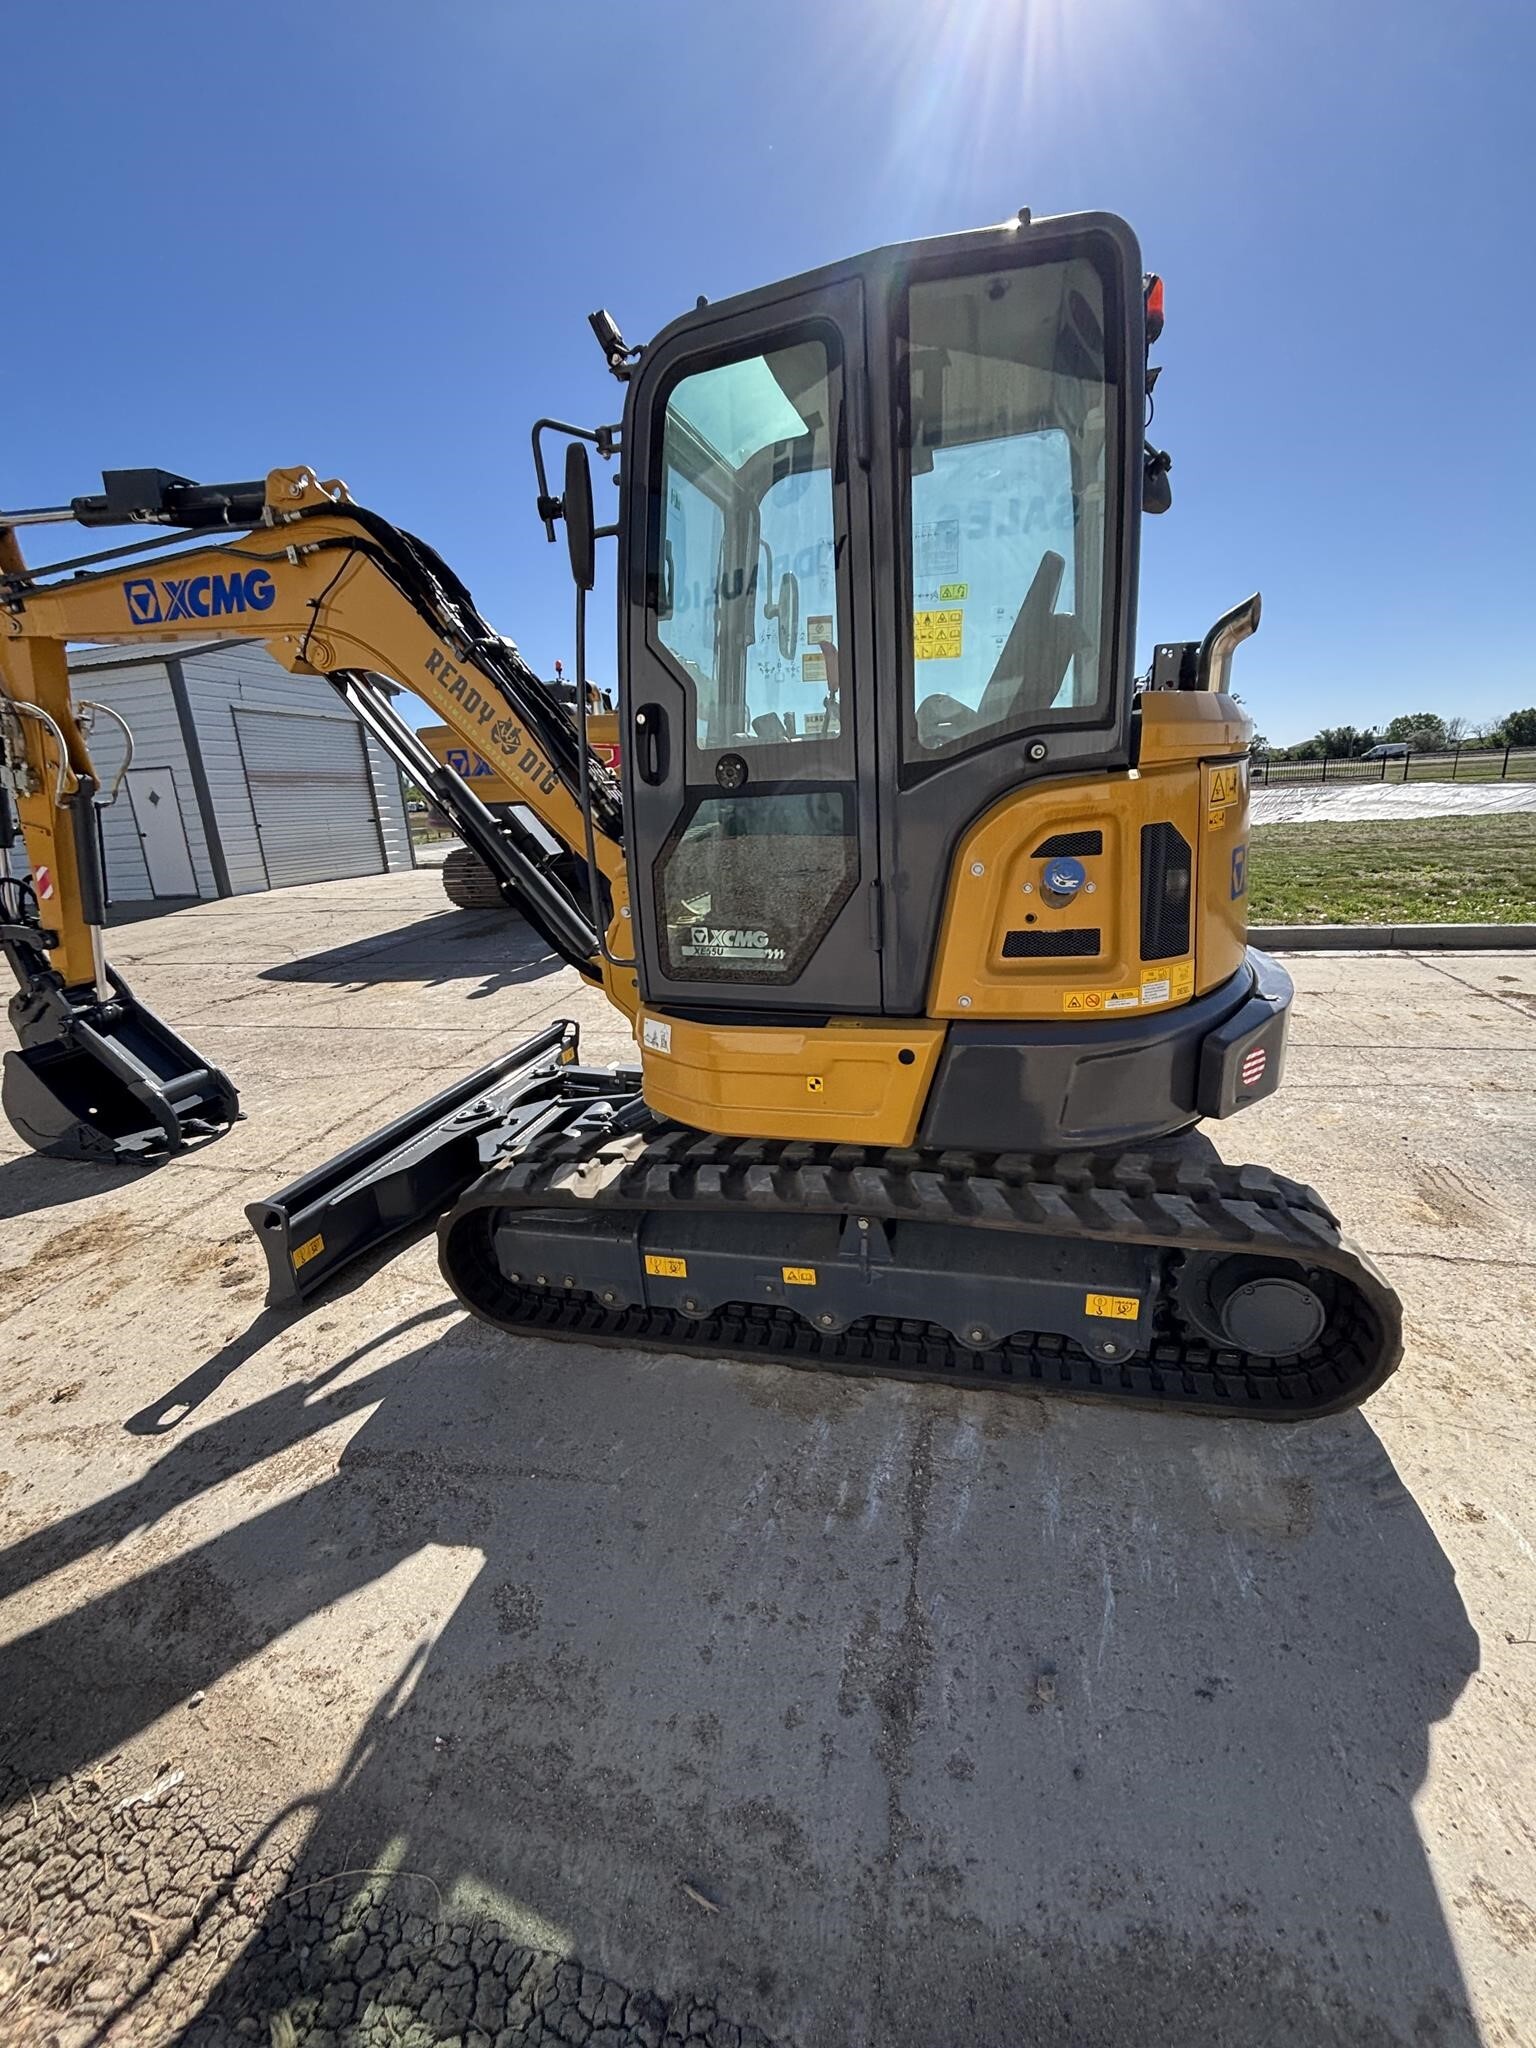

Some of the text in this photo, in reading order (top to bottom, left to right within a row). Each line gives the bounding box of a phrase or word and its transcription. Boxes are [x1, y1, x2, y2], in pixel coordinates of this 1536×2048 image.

[161, 569, 275, 621] XCMG
[424, 648, 496, 725] READY
[518, 748, 559, 796] DIG
[709, 929, 769, 948] XCMG
